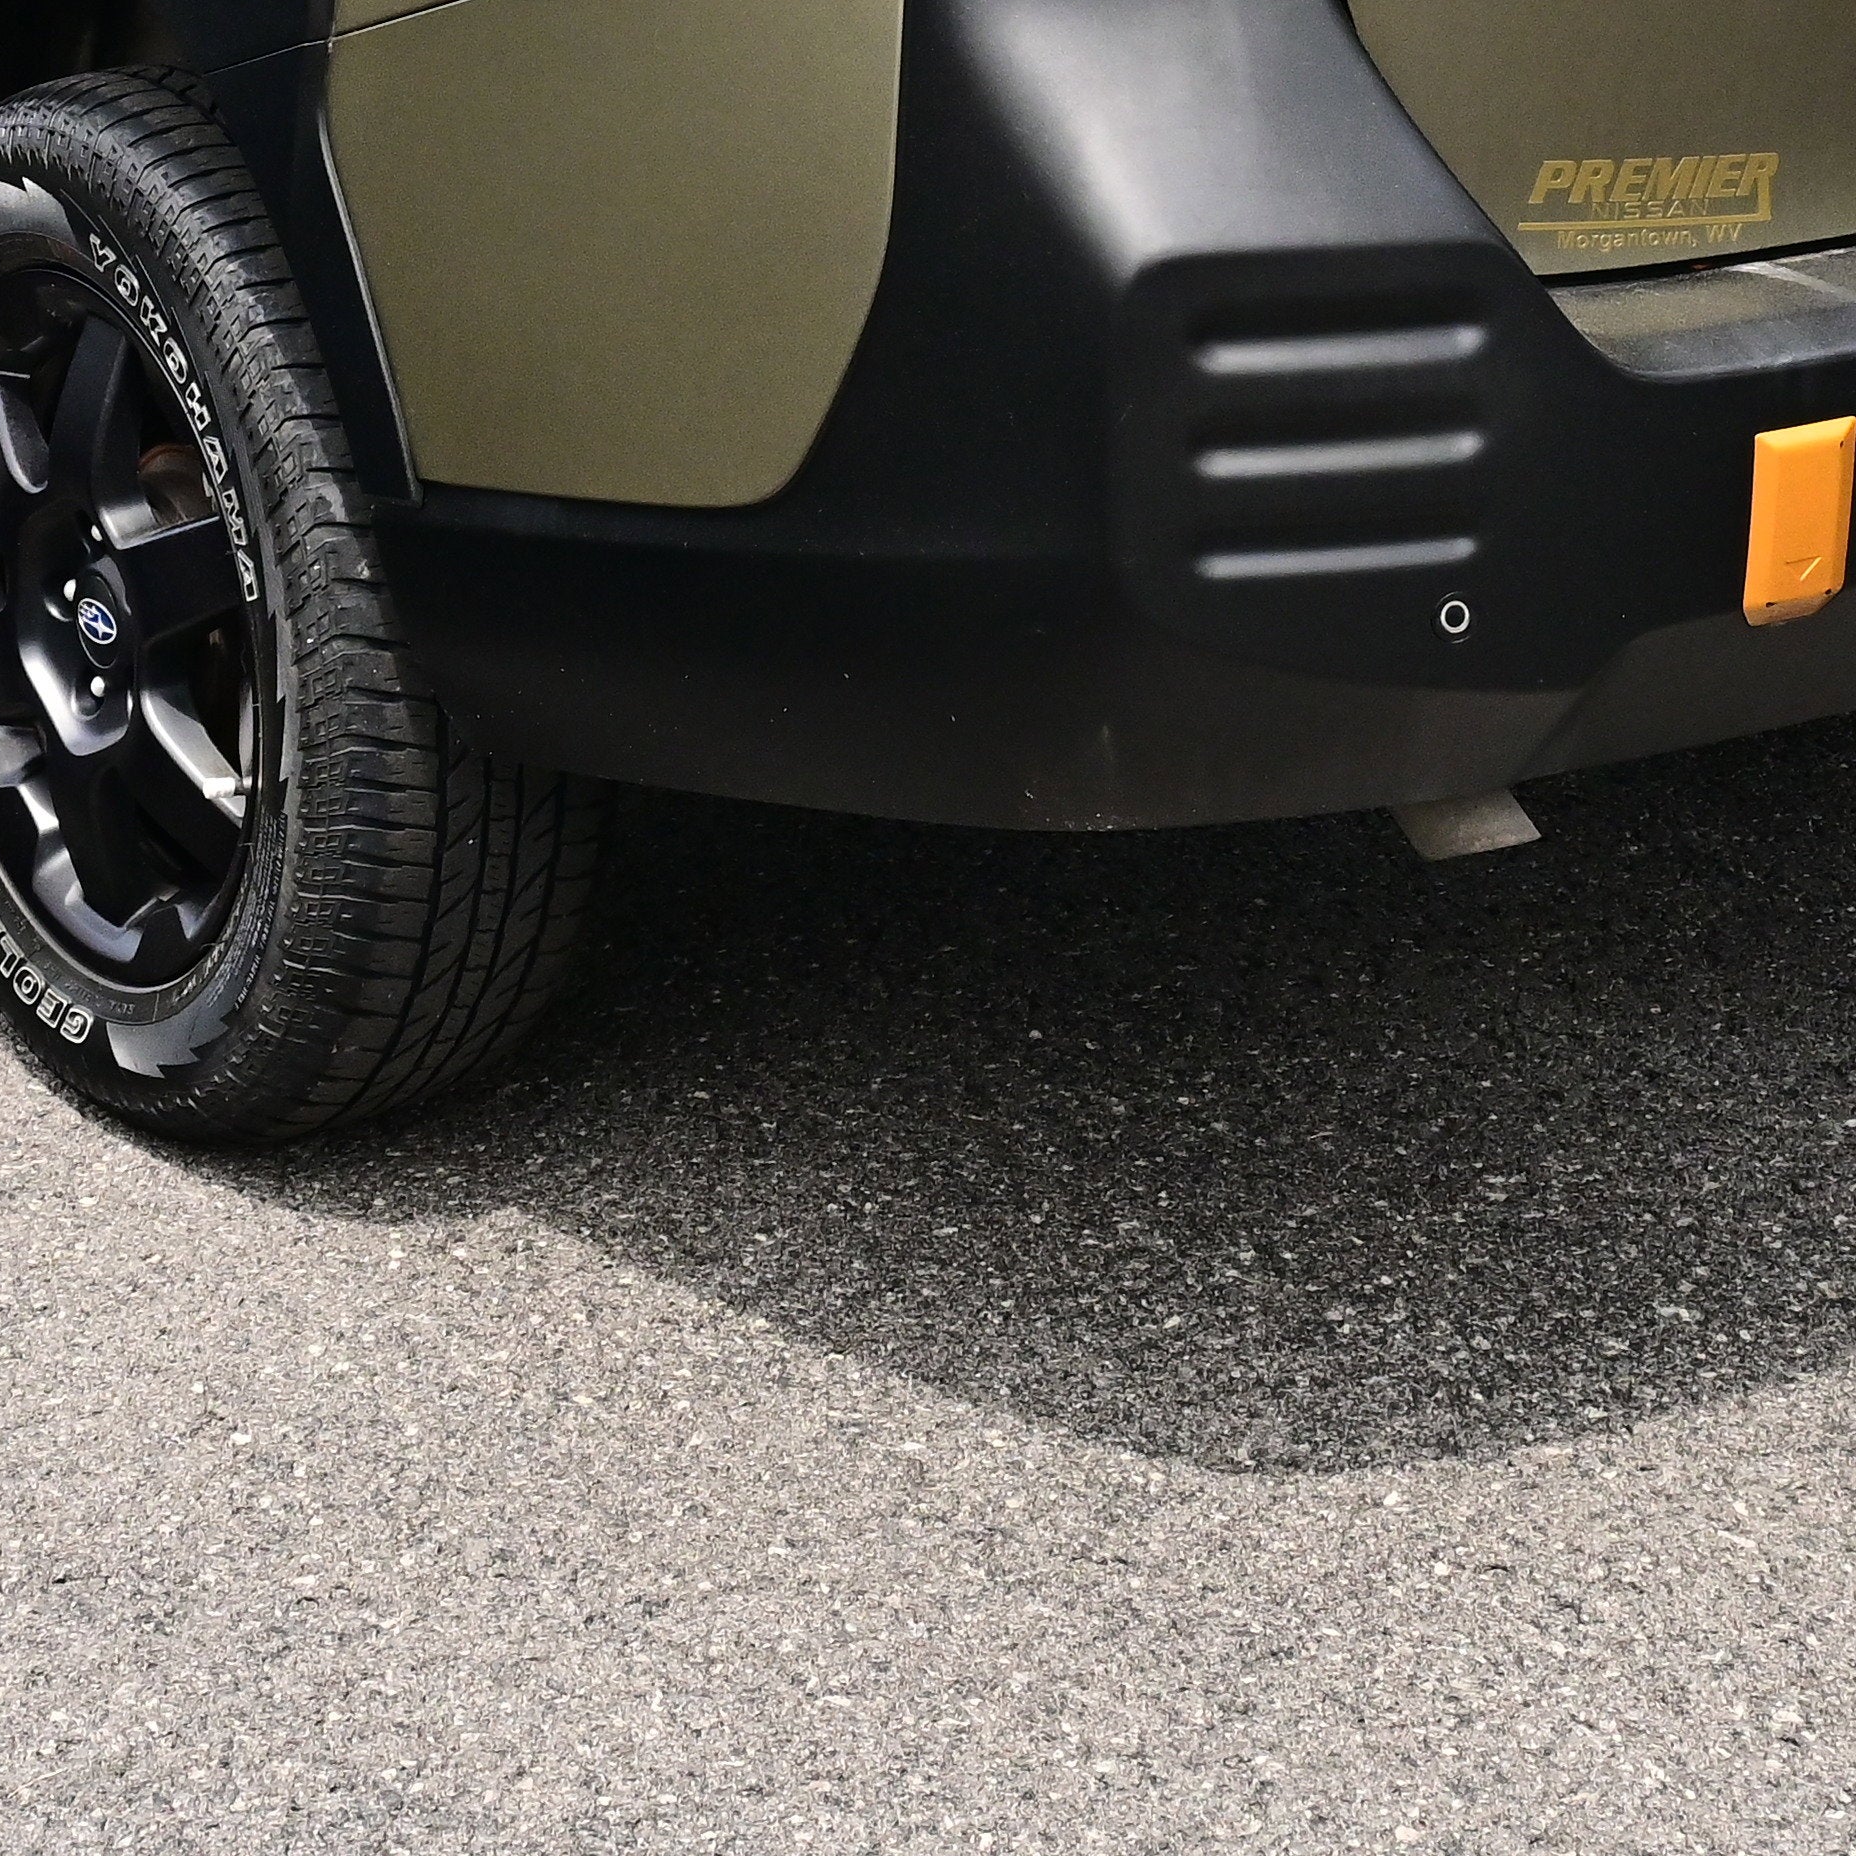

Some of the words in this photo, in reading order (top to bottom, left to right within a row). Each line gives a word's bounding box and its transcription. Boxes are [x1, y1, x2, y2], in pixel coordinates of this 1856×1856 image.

[1527, 151, 1780, 219] PREMIER
[1591, 199, 1711, 221] NISSAN
[1556, 227, 1699, 253] Morgantown,
[1705, 222, 1743, 244] WV
[88, 232, 259, 603] YOKOHAMA
